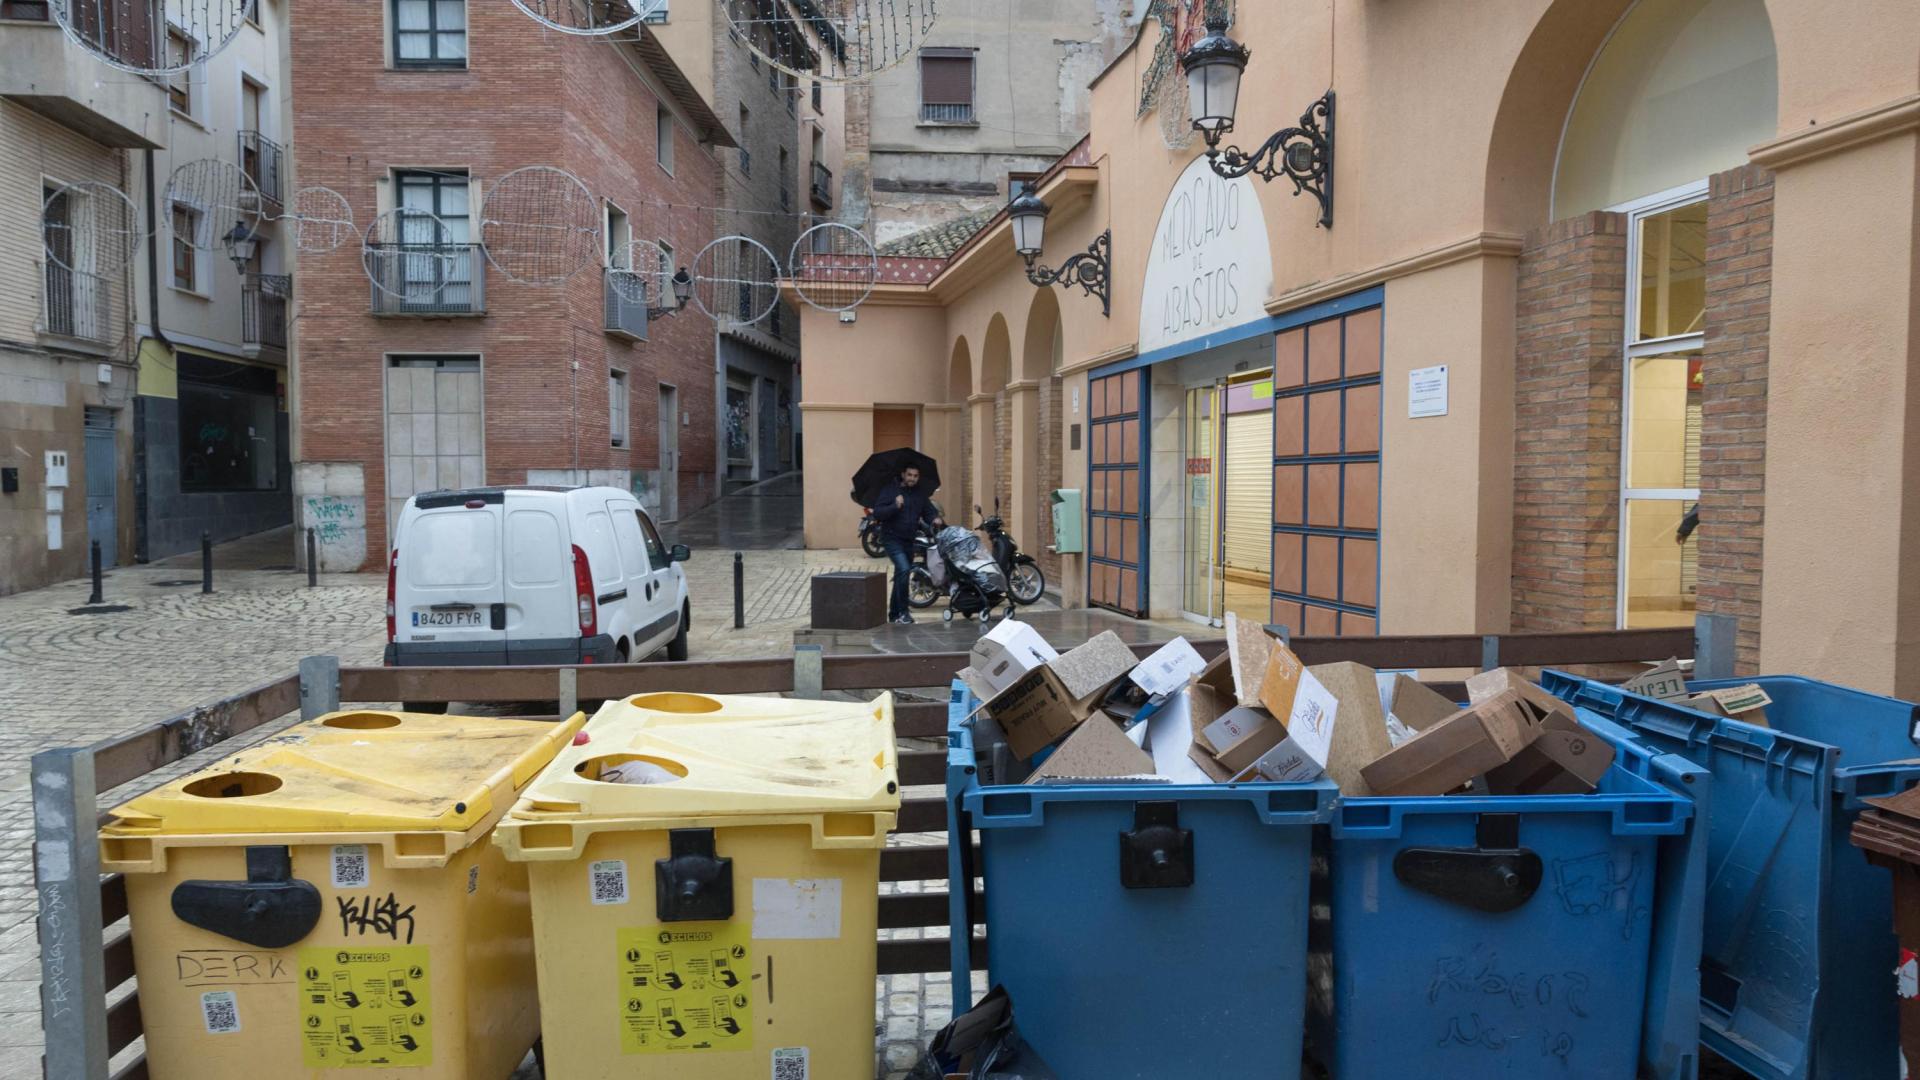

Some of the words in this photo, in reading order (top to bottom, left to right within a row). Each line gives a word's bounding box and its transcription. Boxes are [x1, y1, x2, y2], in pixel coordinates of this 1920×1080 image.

[1162, 175, 1239, 263] MERCADO
[1192, 252, 1203, 271] DE
[1162, 262, 1239, 338] ABASTOS
[421, 613, 453, 625] 8420
[457, 612, 481, 624] FYR
[658, 930, 712, 944] RECICLOS
[176, 953, 287, 980] DERK
